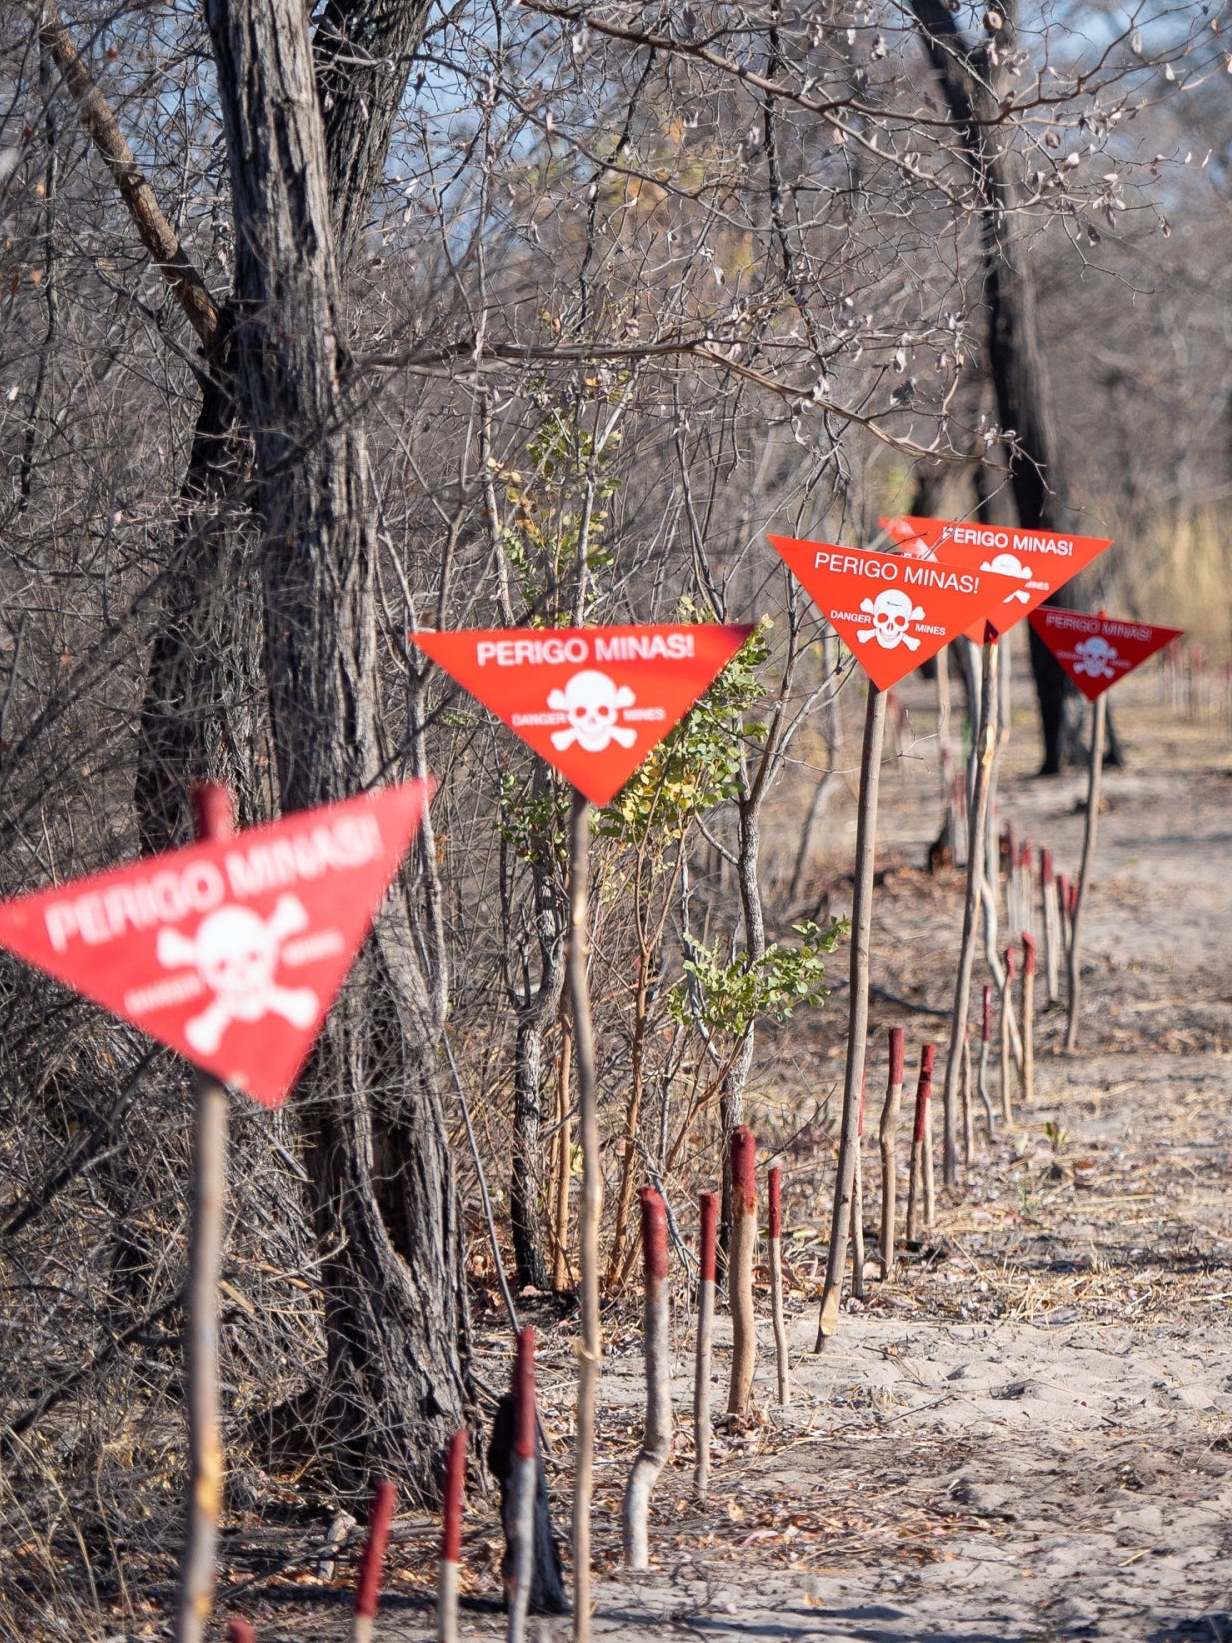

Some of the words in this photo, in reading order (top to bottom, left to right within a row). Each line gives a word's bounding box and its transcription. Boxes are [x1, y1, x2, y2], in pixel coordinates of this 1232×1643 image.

[1013, 534, 1074, 556] MINAS!
[814, 551, 898, 581] PERIGO
[903, 566, 980, 594] MINAS!
[830, 609, 872, 624] DANGER
[915, 623, 947, 636] MINES
[476, 638, 589, 667] PERIGO
[594, 633, 696, 662] MINAS!
[511, 711, 568, 726] DANGER
[46, 861, 223, 952] PERIGO
